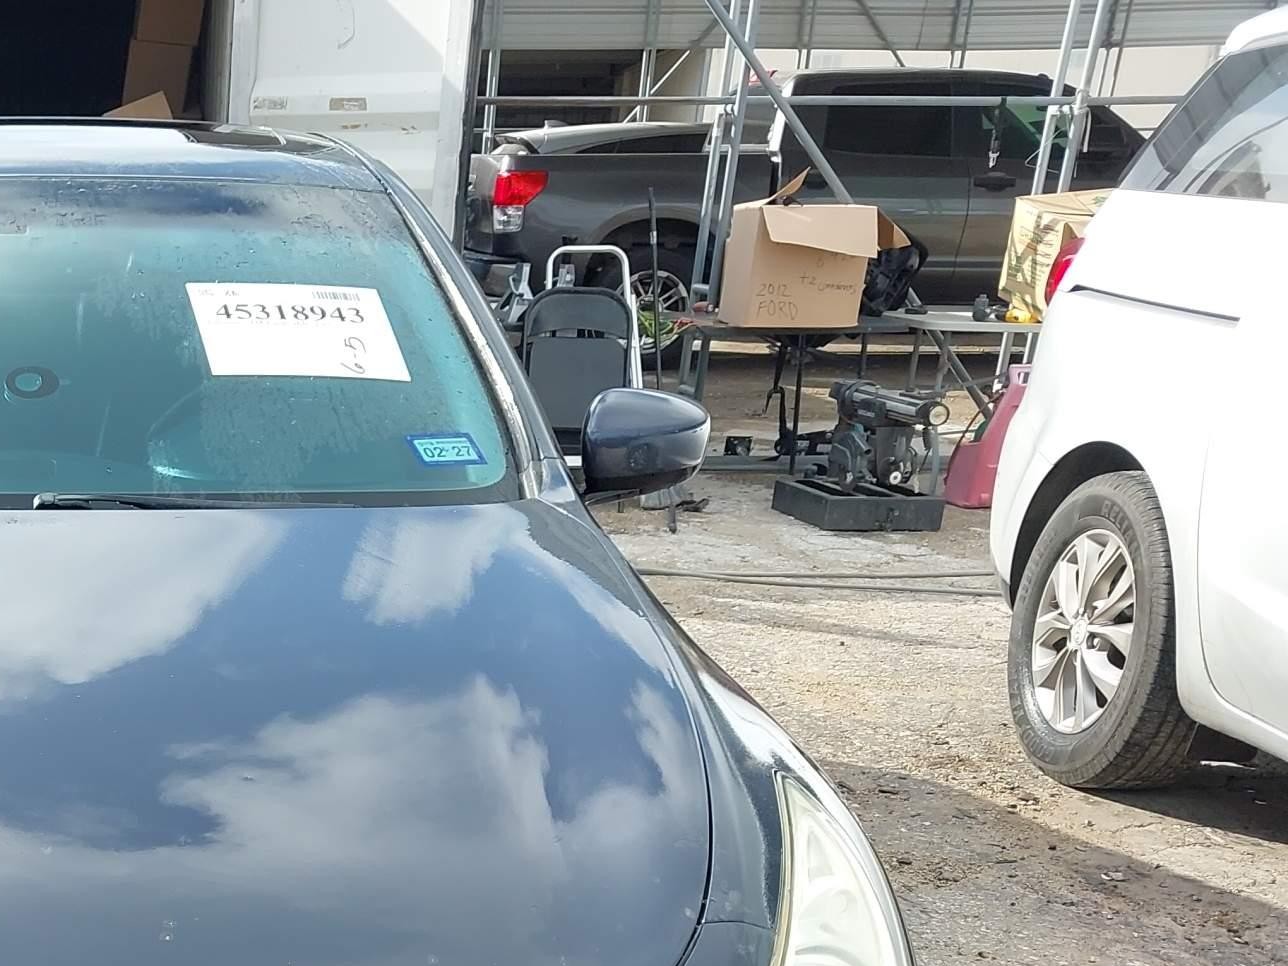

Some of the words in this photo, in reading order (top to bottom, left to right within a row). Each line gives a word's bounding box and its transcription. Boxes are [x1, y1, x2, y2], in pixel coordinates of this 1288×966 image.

[756, 283, 791, 297] 2012
[215, 303, 365, 324] 45318943
[757, 300, 799, 321] FORD
